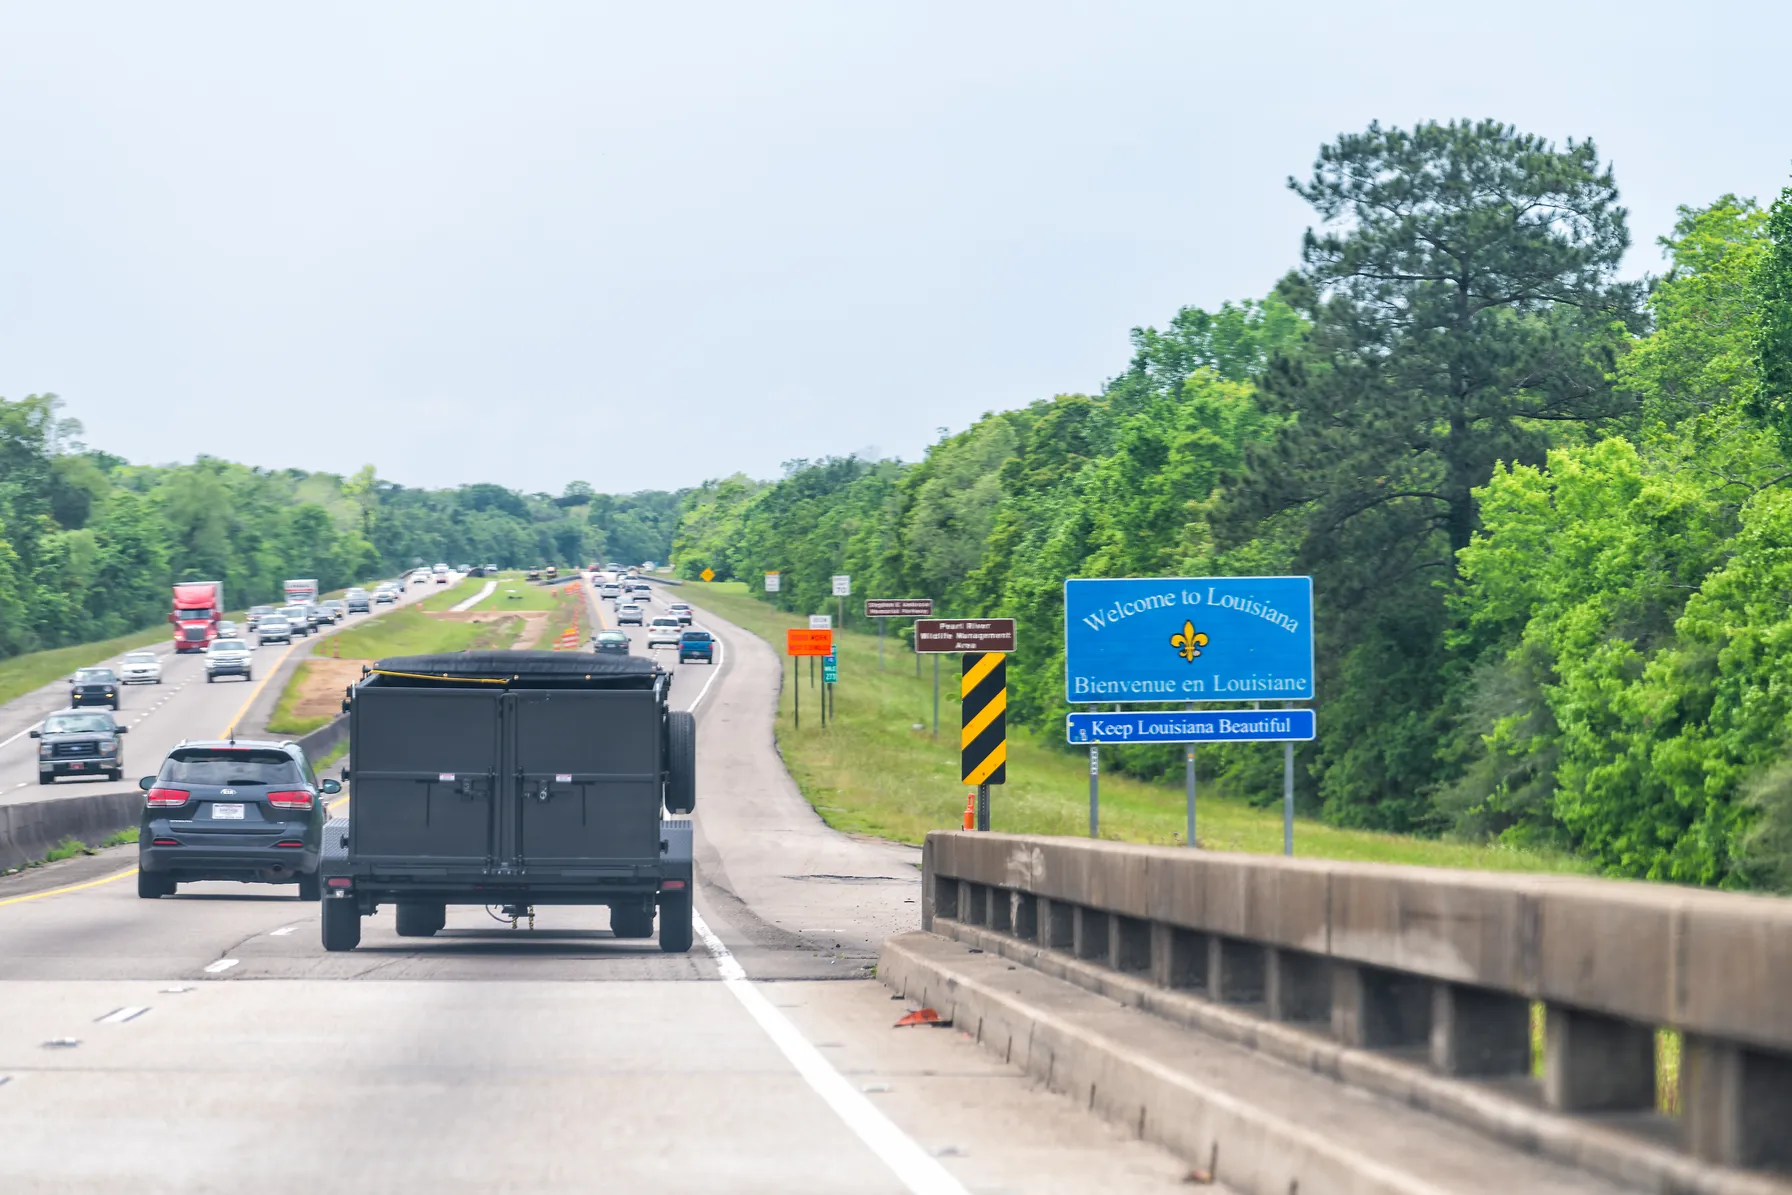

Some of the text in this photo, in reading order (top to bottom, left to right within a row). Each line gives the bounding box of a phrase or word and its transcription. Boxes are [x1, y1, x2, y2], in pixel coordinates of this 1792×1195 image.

[1082, 587, 1299, 633] Welcome to Louisiana
[920, 632, 1011, 640] Wildlife Management
[1074, 673, 1307, 694] Bienvenue en Louisiane
[1091, 720, 1133, 739] Keep
[1138, 719, 1214, 735] Louisiana
[1219, 717, 1291, 733] Beautiful
